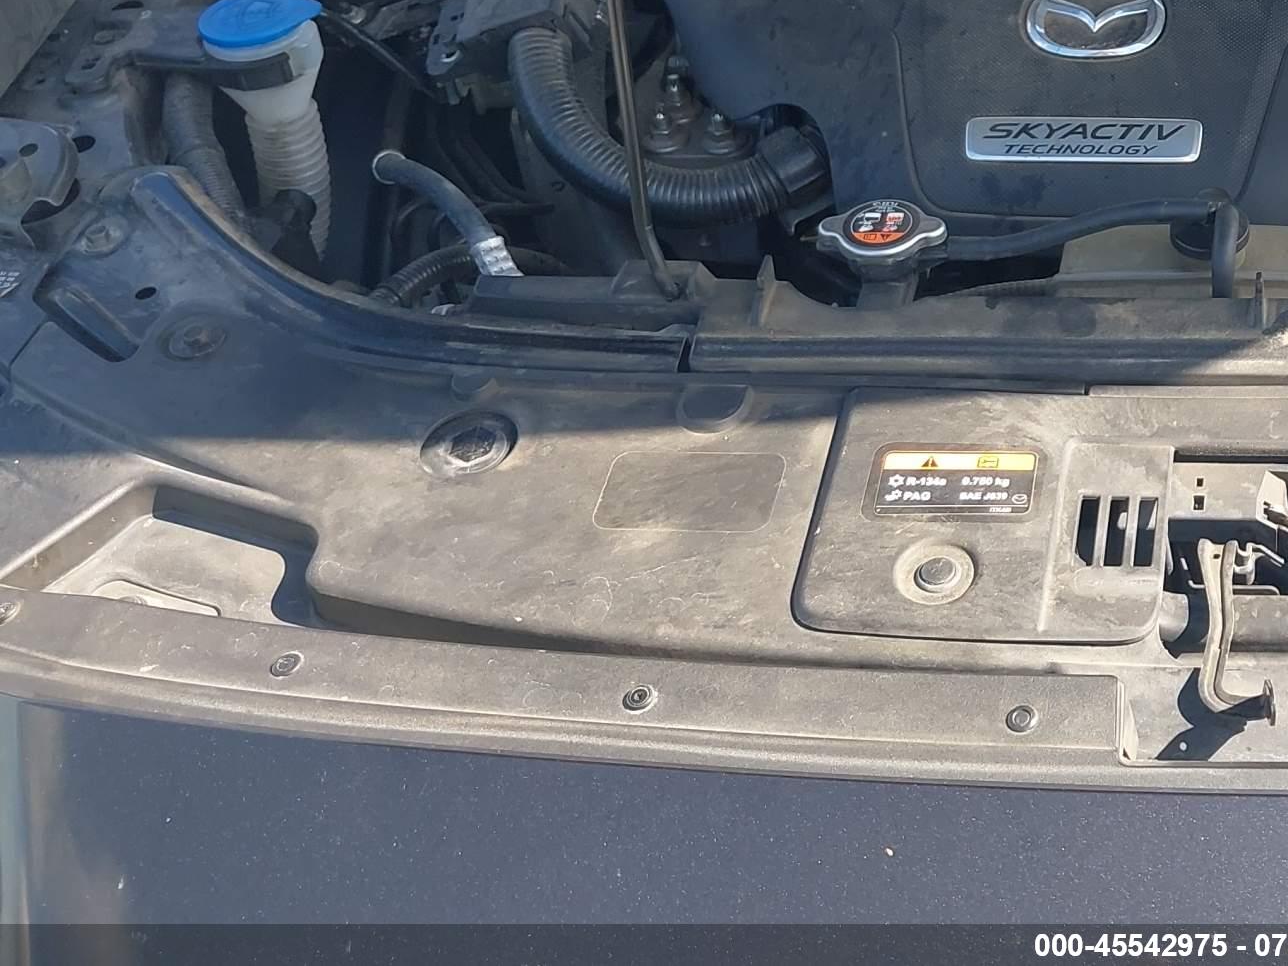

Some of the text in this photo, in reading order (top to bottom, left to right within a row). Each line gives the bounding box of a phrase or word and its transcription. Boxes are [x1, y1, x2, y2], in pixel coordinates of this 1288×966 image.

[982, 122, 1186, 141] SKYACTIV
[1004, 143, 1158, 155] TECHNOLOGY
[994, 476, 1010, 488] kg
[902, 490, 931, 501] PAG
